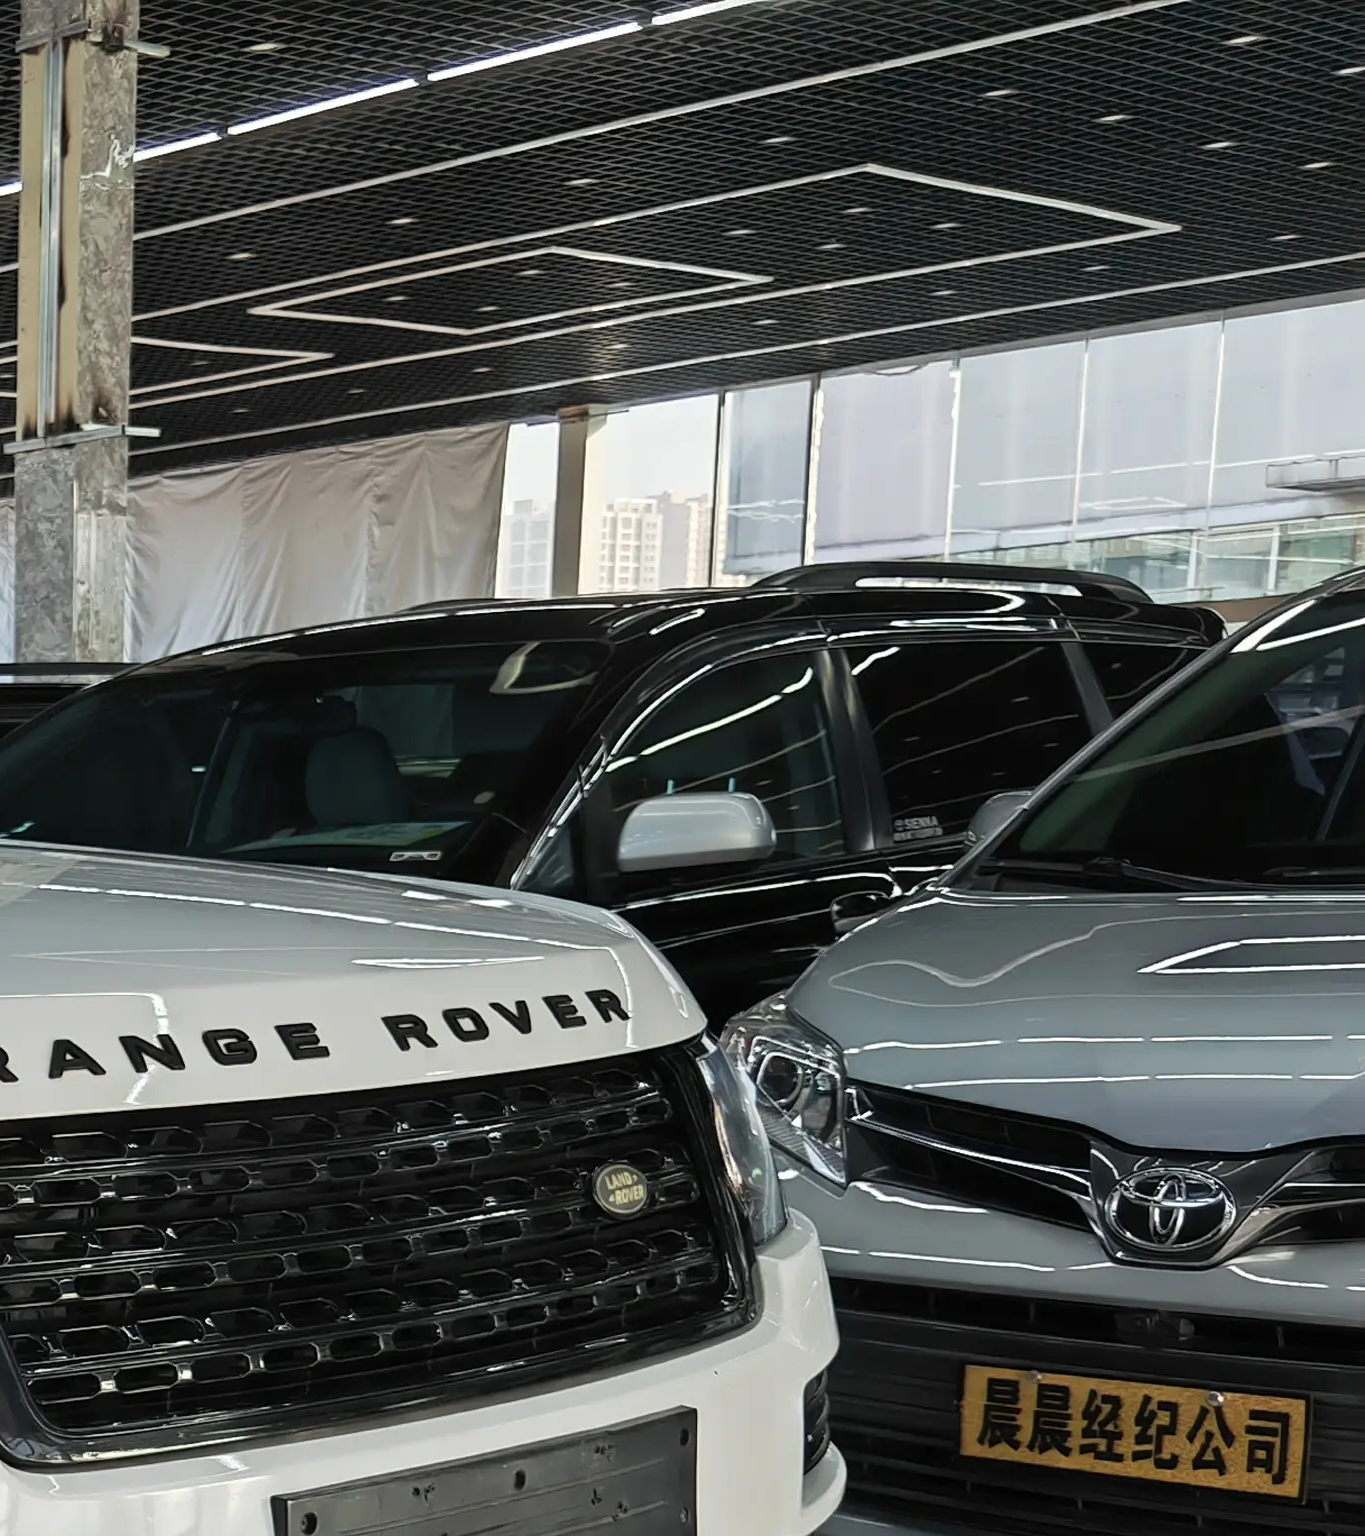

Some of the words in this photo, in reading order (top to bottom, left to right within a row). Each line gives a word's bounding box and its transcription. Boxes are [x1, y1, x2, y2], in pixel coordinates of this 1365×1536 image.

[381, 988, 631, 1052] ROVER
[604, 1171, 633, 1190] LAND
[614, 1184, 644, 1206] ROVER
[976, 1376, 1291, 1486] 晨晨经纪公司
